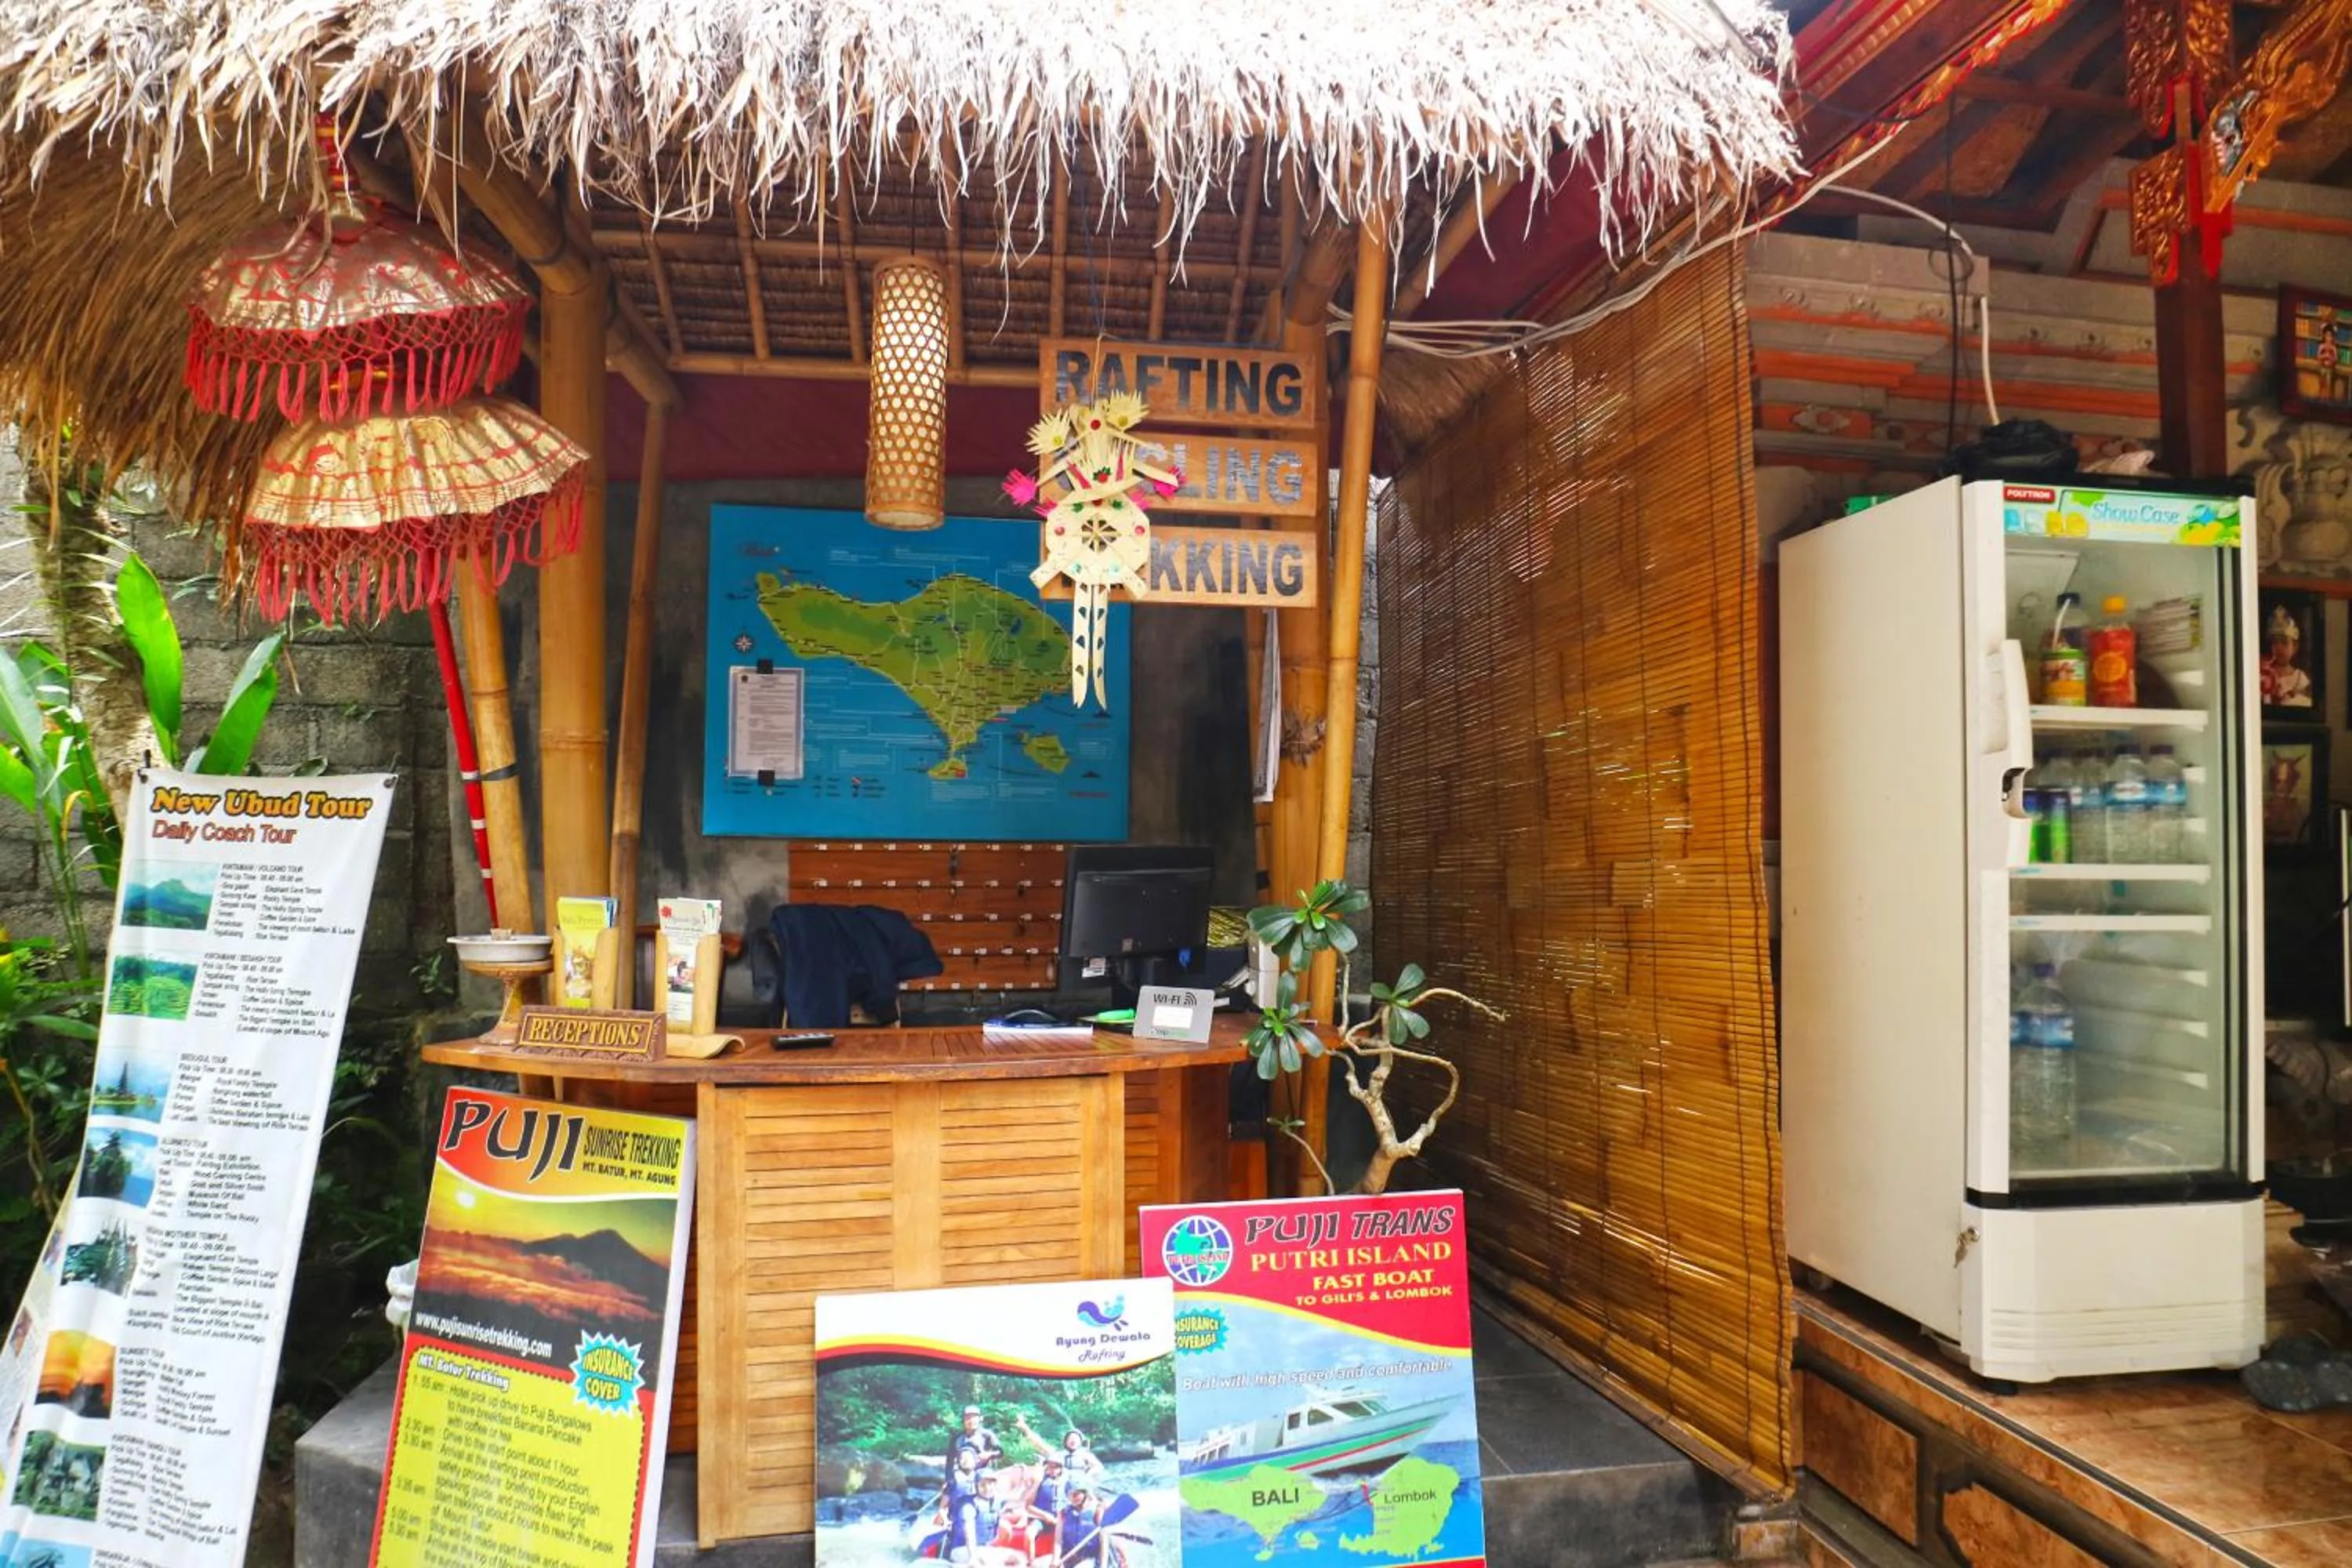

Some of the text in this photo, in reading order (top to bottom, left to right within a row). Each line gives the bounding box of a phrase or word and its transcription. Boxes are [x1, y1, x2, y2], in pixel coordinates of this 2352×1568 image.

[1055, 350, 1302, 416] RAFTING
[1054, 437, 1302, 505] LING
[2006, 489, 2051, 499] POLYTRON
[1058, 538, 1304, 597] KKING
[151, 786, 372, 818] New Ubud Tour
[152, 820, 296, 844] Daily Coach Tour
[530, 1018, 641, 1045] RECEPTIONS
[445, 1099, 584, 1181] PUJI
[584, 1126, 681, 1169] SUNRISE TREKKING
[583, 1162, 596, 1173] MT.
[1244, 1205, 1456, 1248] PUJI TRANS
[1251, 1242, 1453, 1272] PUTRI ISLAND
[1312, 1269, 1436, 1291] FAST BOAT
[1295, 1295, 1317, 1305] TO
[1370, 1290, 1381, 1301] &
[1386, 1285, 1454, 1299] LOMBOK
[416, 1312, 553, 1359] www.pujisunrisetrekking.com
[1175, 1334, 1217, 1349] OVERAGE
[585, 1377, 621, 1401] COVER
[1251, 1486, 1437, 1507] BALI Lombok
